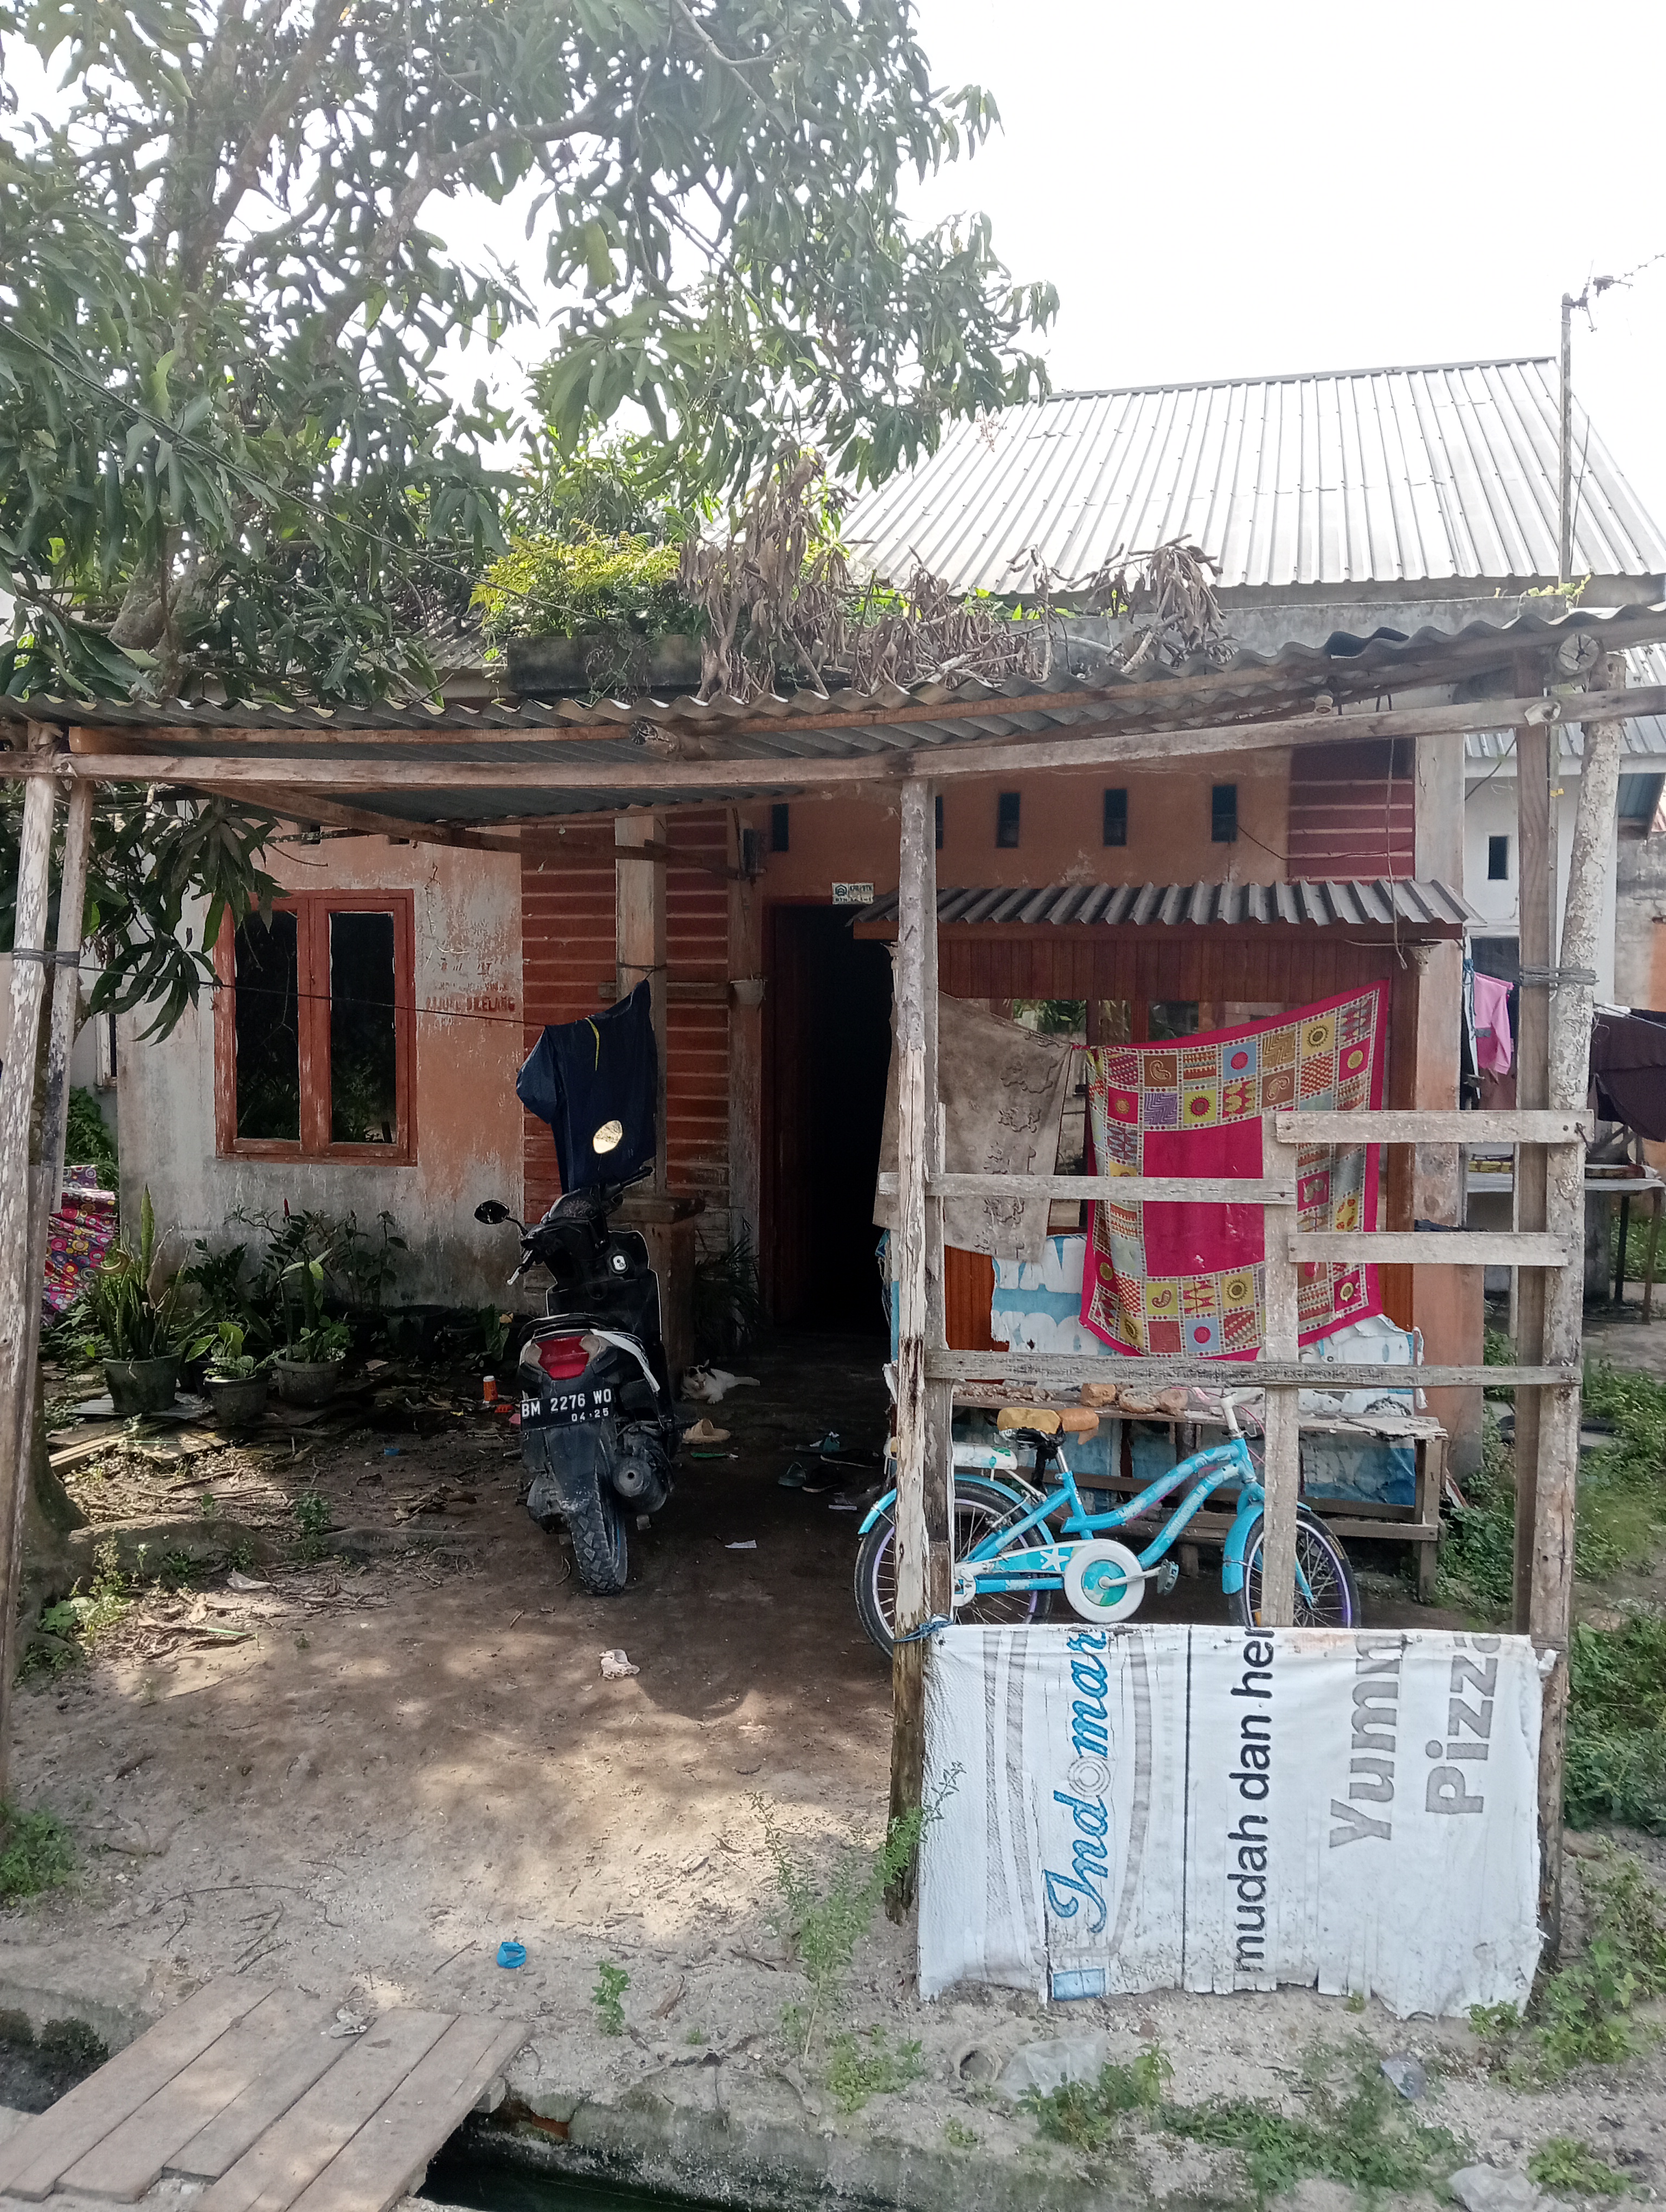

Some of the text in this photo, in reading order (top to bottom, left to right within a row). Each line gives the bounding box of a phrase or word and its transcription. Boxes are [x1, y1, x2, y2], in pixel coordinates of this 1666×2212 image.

[522, 1388, 612, 1418] BM 2276 WO
[1228, 1715, 1272, 1801] dan
[1227, 1816, 1269, 1972] mudah
